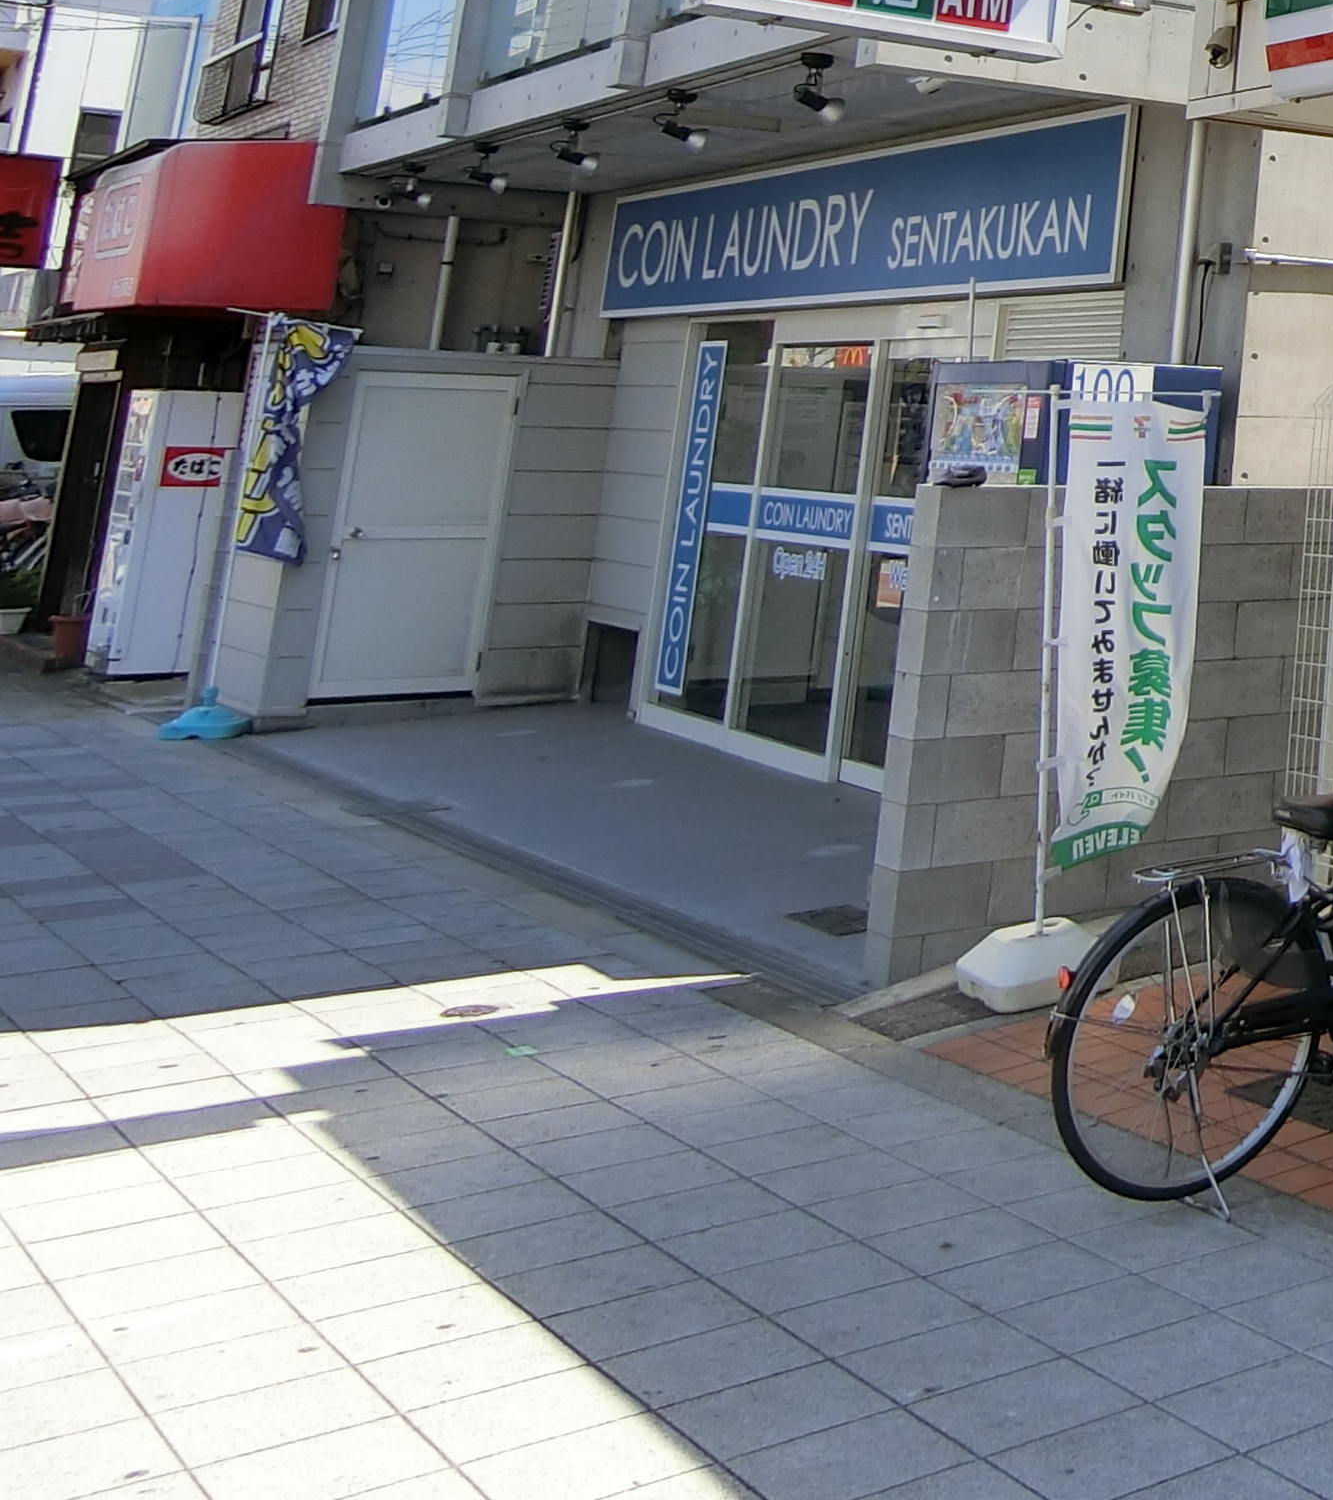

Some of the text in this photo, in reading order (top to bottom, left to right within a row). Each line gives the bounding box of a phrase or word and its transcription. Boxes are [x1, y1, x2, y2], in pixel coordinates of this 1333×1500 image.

[617, 189, 1092, 288] COIN LAUNDRY SENTAKUKAN
[171, 455, 222, 478] たばこ
[680, 350, 718, 548] LAUNDRY
[763, 501, 794, 526] COIN
[796, 503, 852, 533] LAUNDRY
[664, 562, 691, 681] COIN
